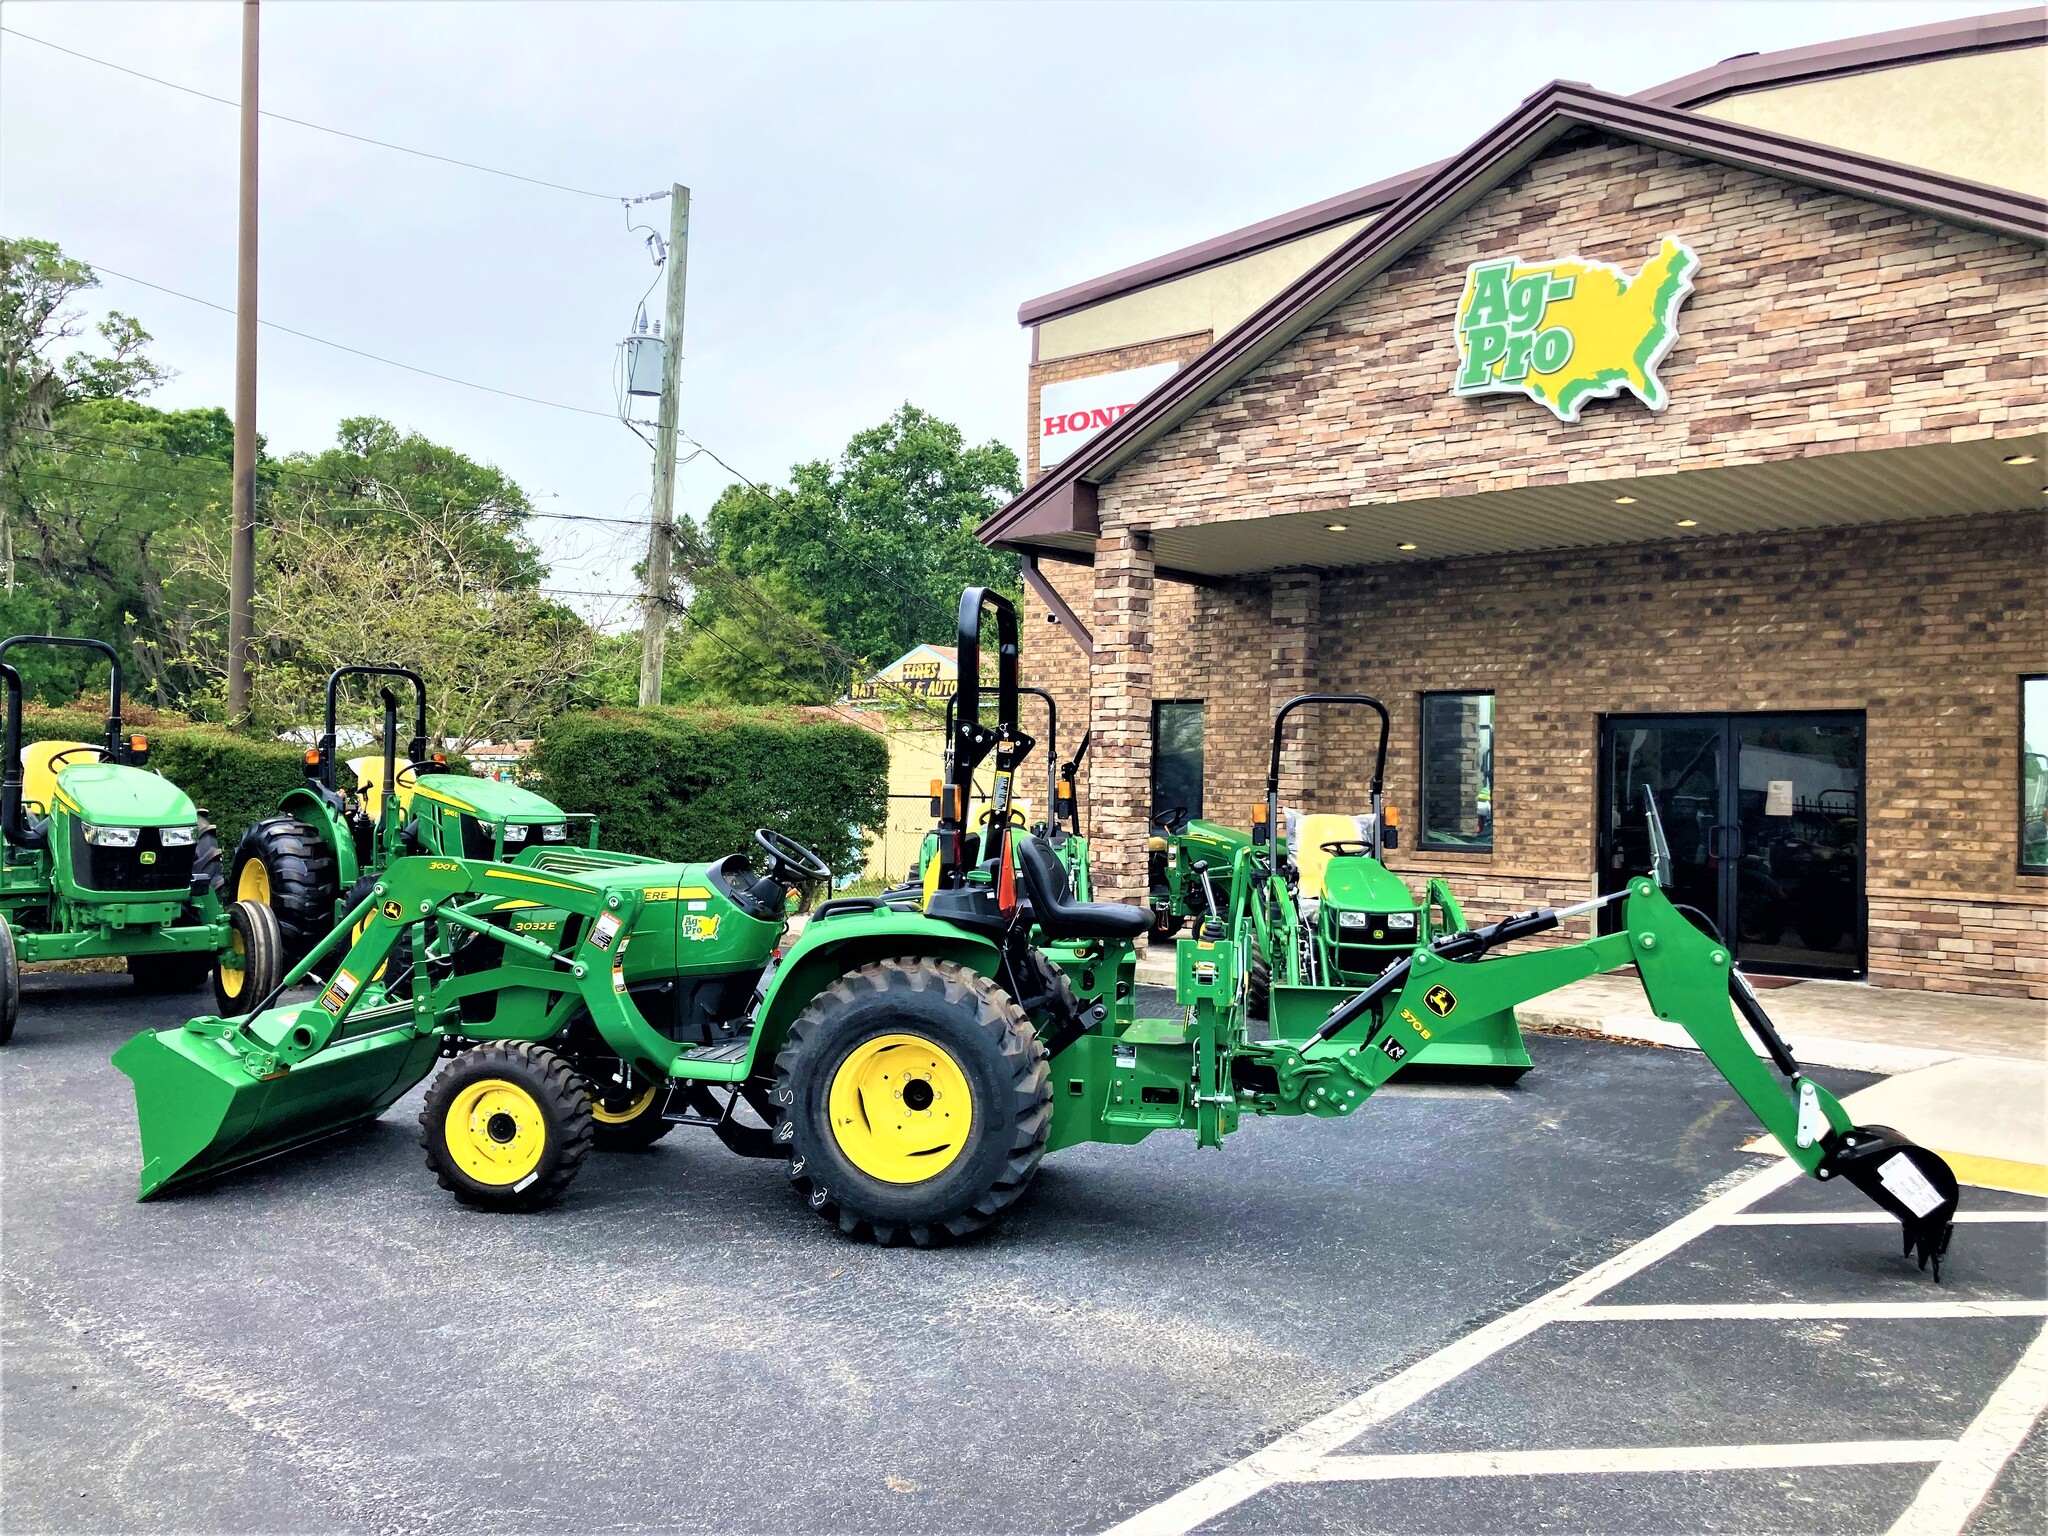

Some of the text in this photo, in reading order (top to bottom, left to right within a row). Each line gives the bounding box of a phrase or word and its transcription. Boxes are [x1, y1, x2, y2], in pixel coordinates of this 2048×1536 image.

[1462, 263, 1575, 333] Ag-
[1460, 324, 1574, 387] Pro
[927, 680, 958, 697] AUTO
[684, 926, 703, 935] Pro
